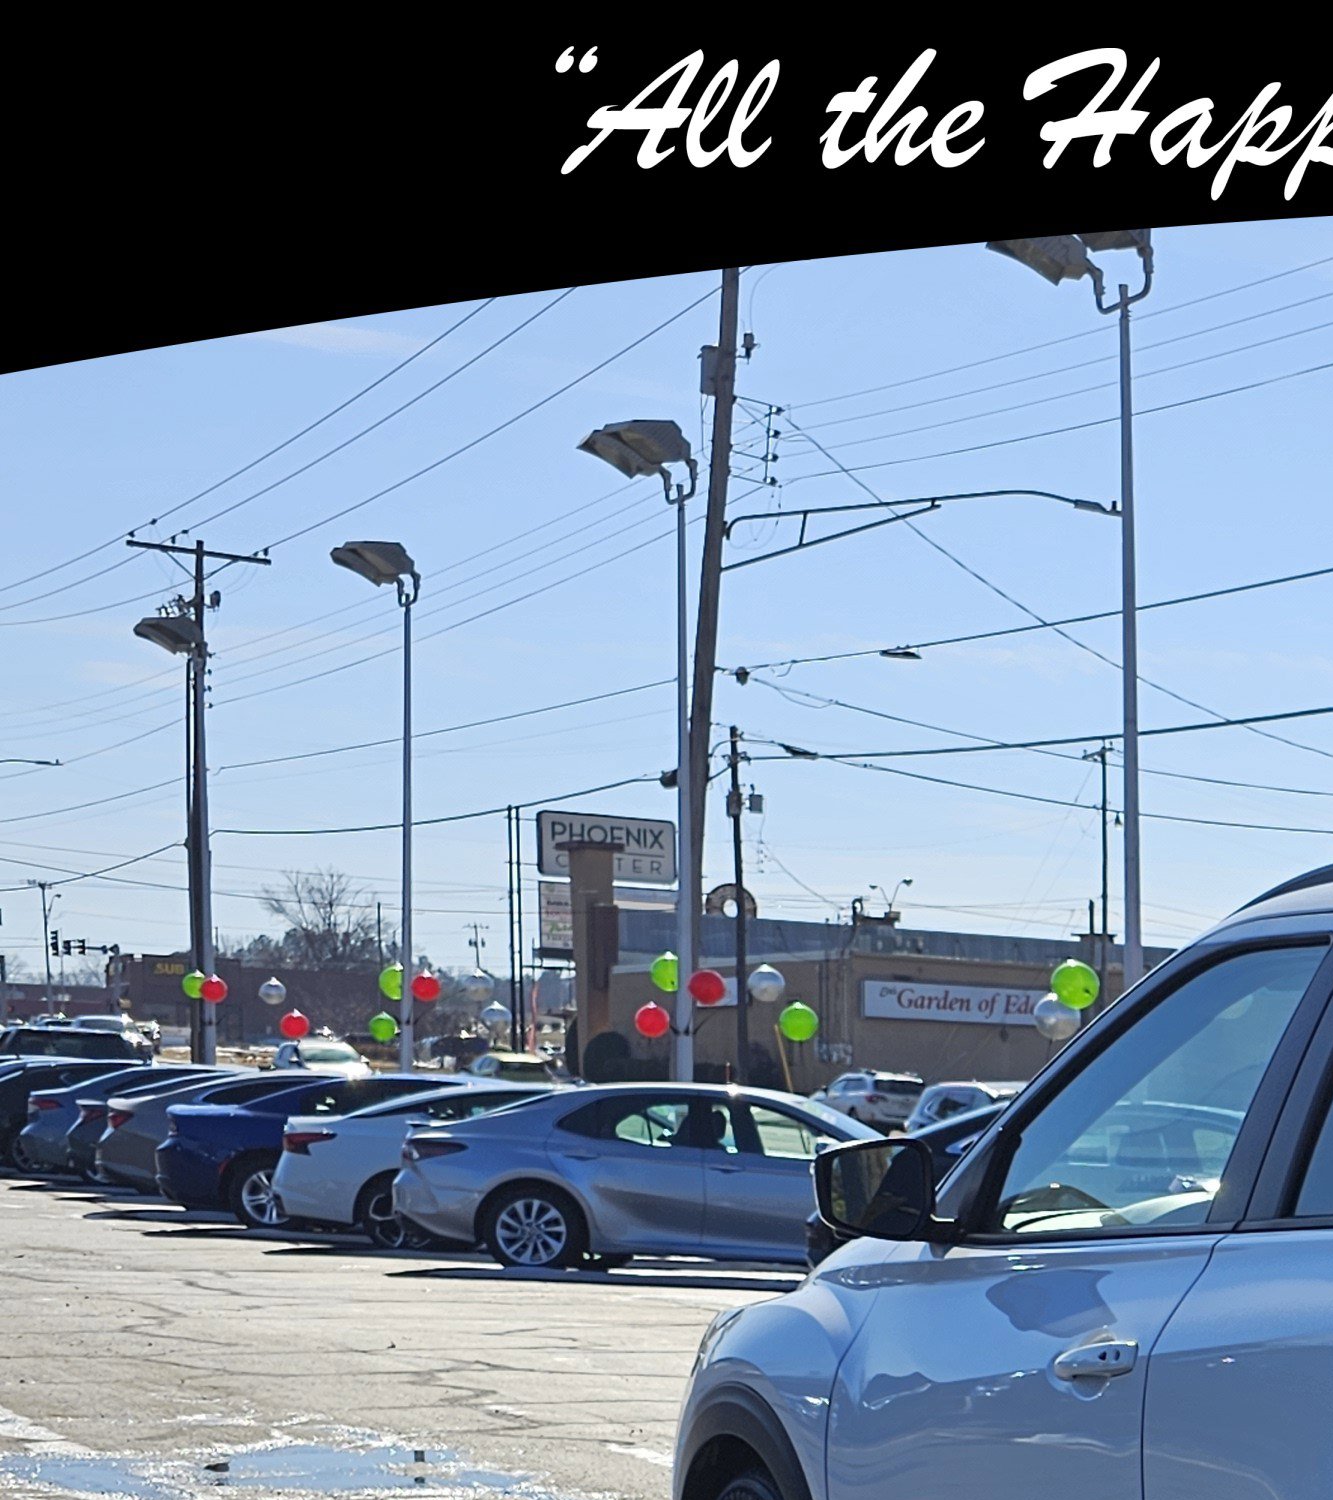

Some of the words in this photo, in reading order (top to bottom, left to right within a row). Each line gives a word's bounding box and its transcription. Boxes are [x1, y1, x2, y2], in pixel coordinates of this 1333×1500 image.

[550, 820, 665, 850] PHOENIX
[555, 854, 662, 876] CTER
[896, 988, 972, 1012] Garden
[978, 993, 1001, 1018] of
[1003, 993, 1036, 1016] Ed
